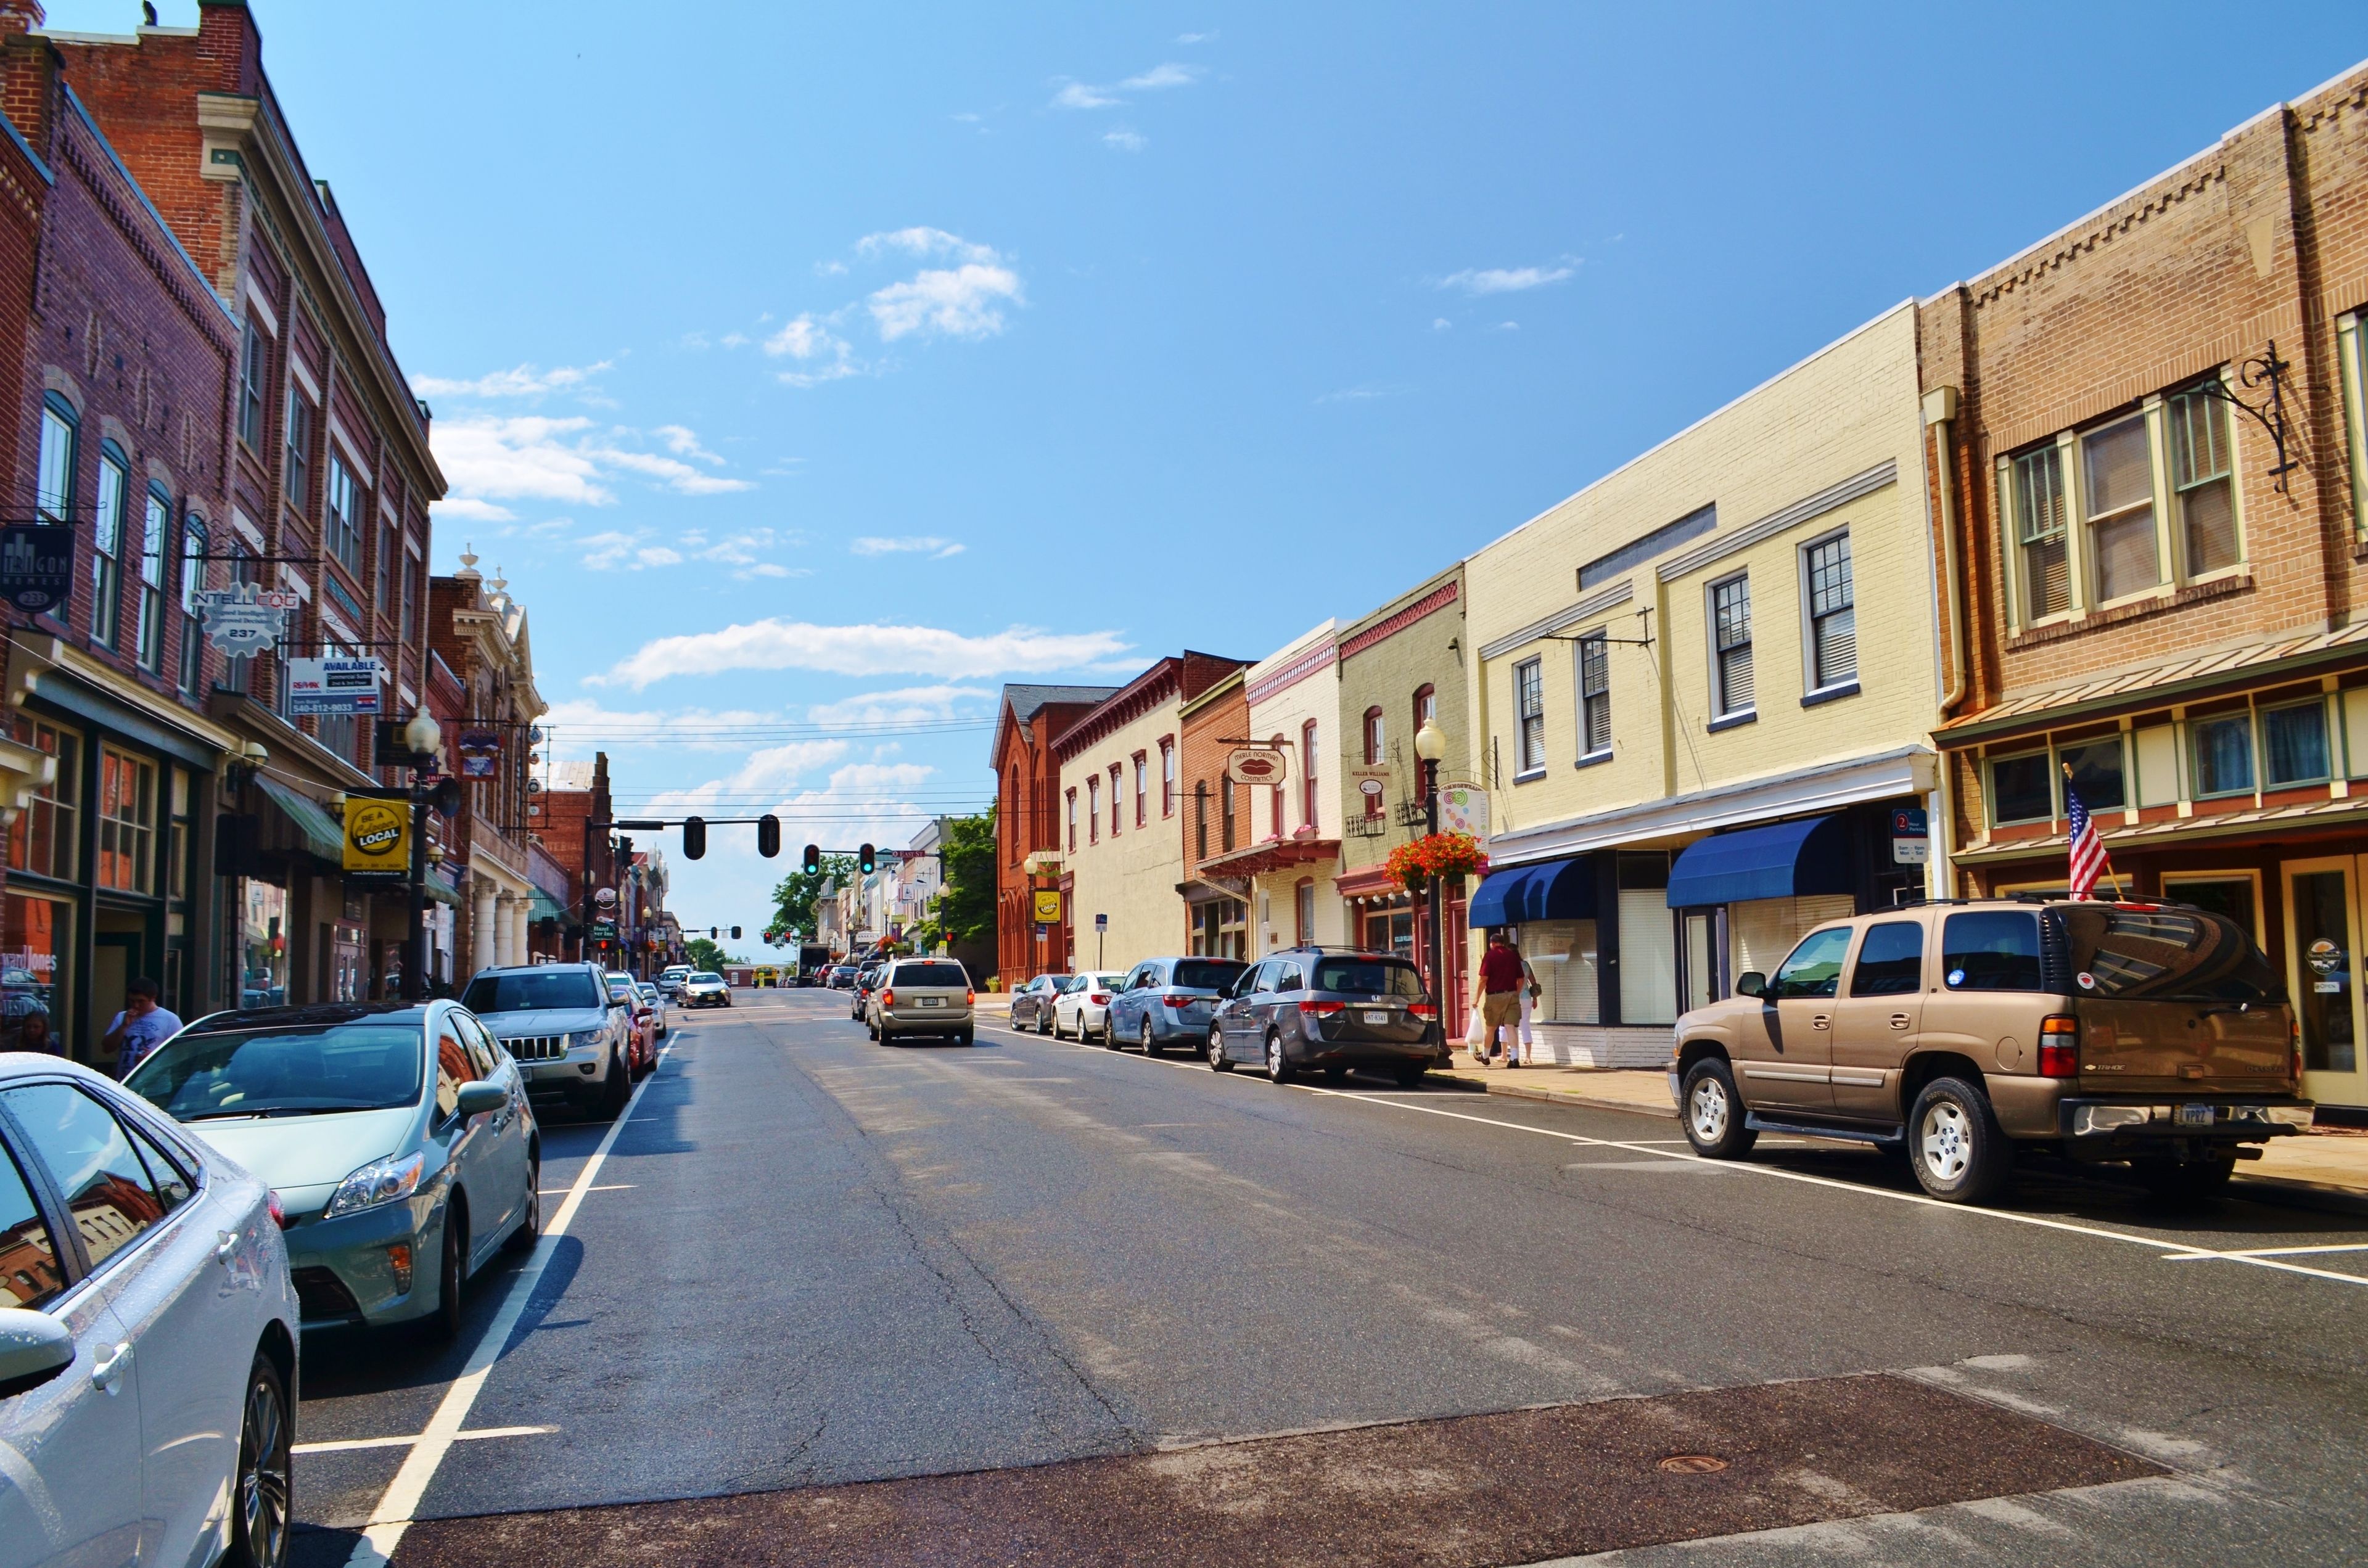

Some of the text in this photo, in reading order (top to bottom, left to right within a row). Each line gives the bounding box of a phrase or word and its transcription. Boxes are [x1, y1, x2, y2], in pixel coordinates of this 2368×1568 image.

[2, 577, 60, 585] HOMES
[23, 593, 45, 604] 233
[229, 629, 257, 638] 237
[324, 662, 376, 671] AVAILABLE
[293, 704, 352, 713] 540-812-9033
[1235, 752, 1278, 762] MERLE NORMAN
[361, 814, 374, 823] BE
[1899, 818, 1906, 827] 2
[360, 829, 399, 847] LOCAL
[1041, 903, 1056, 912] LOCAL
[28, 945, 57, 971] Jones
